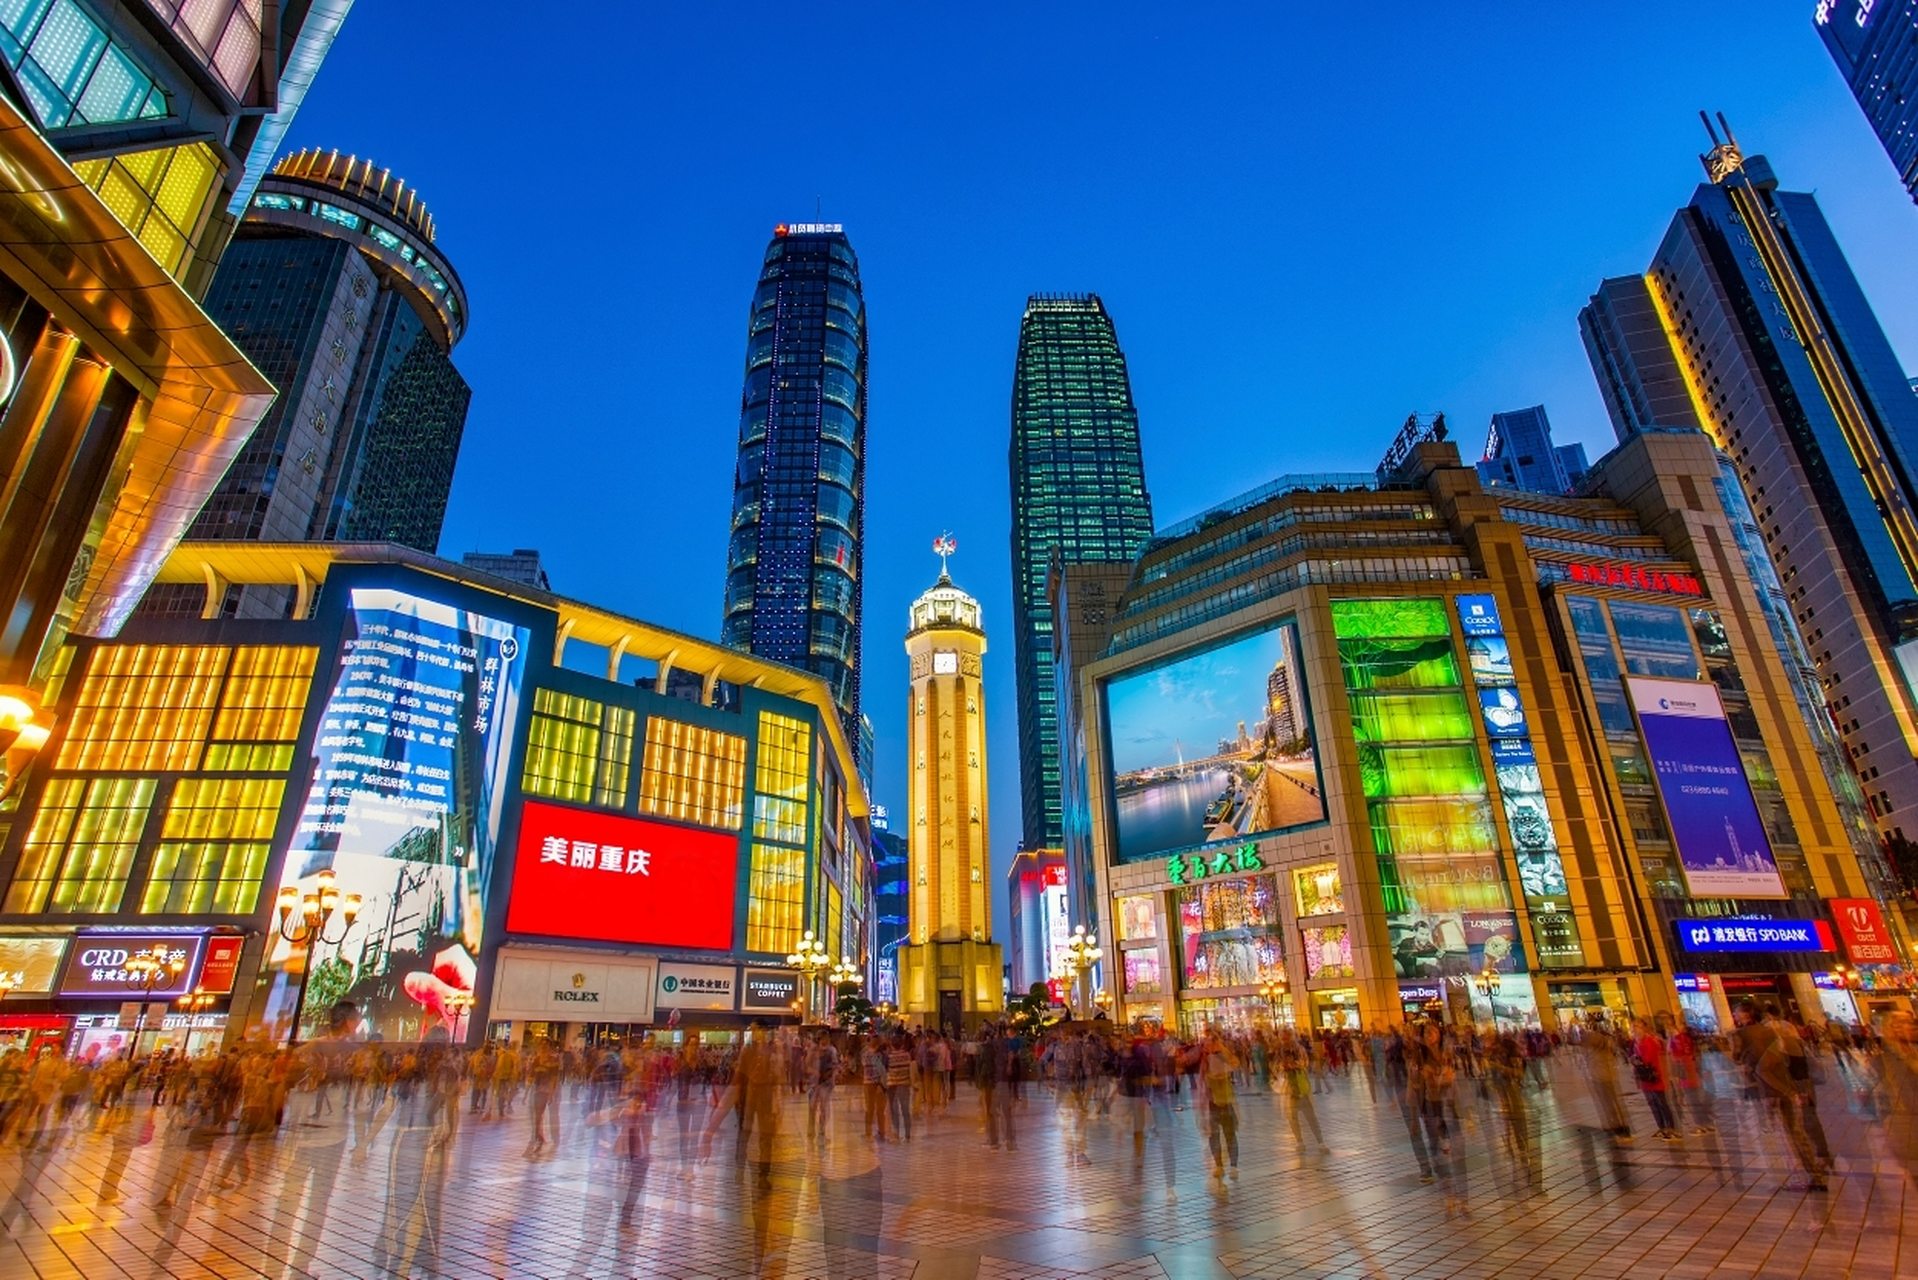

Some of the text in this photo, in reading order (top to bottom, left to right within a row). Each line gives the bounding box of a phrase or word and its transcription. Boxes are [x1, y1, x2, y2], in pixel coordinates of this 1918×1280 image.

[473, 658, 499, 734] 群林市场
[540, 836, 652, 876] 美丽重庆
[1713, 927, 1809, 942] 浦发银行 SPD BANK
[81, 949, 128, 966] CRD
[1851, 945, 1892, 958] 重百超市
[680, 977, 731, 989] 中国农业银行
[749, 981, 793, 991] STARBUCKS
[554, 990, 599, 1002] ROLEX
[757, 990, 785, 998] COFFEE
